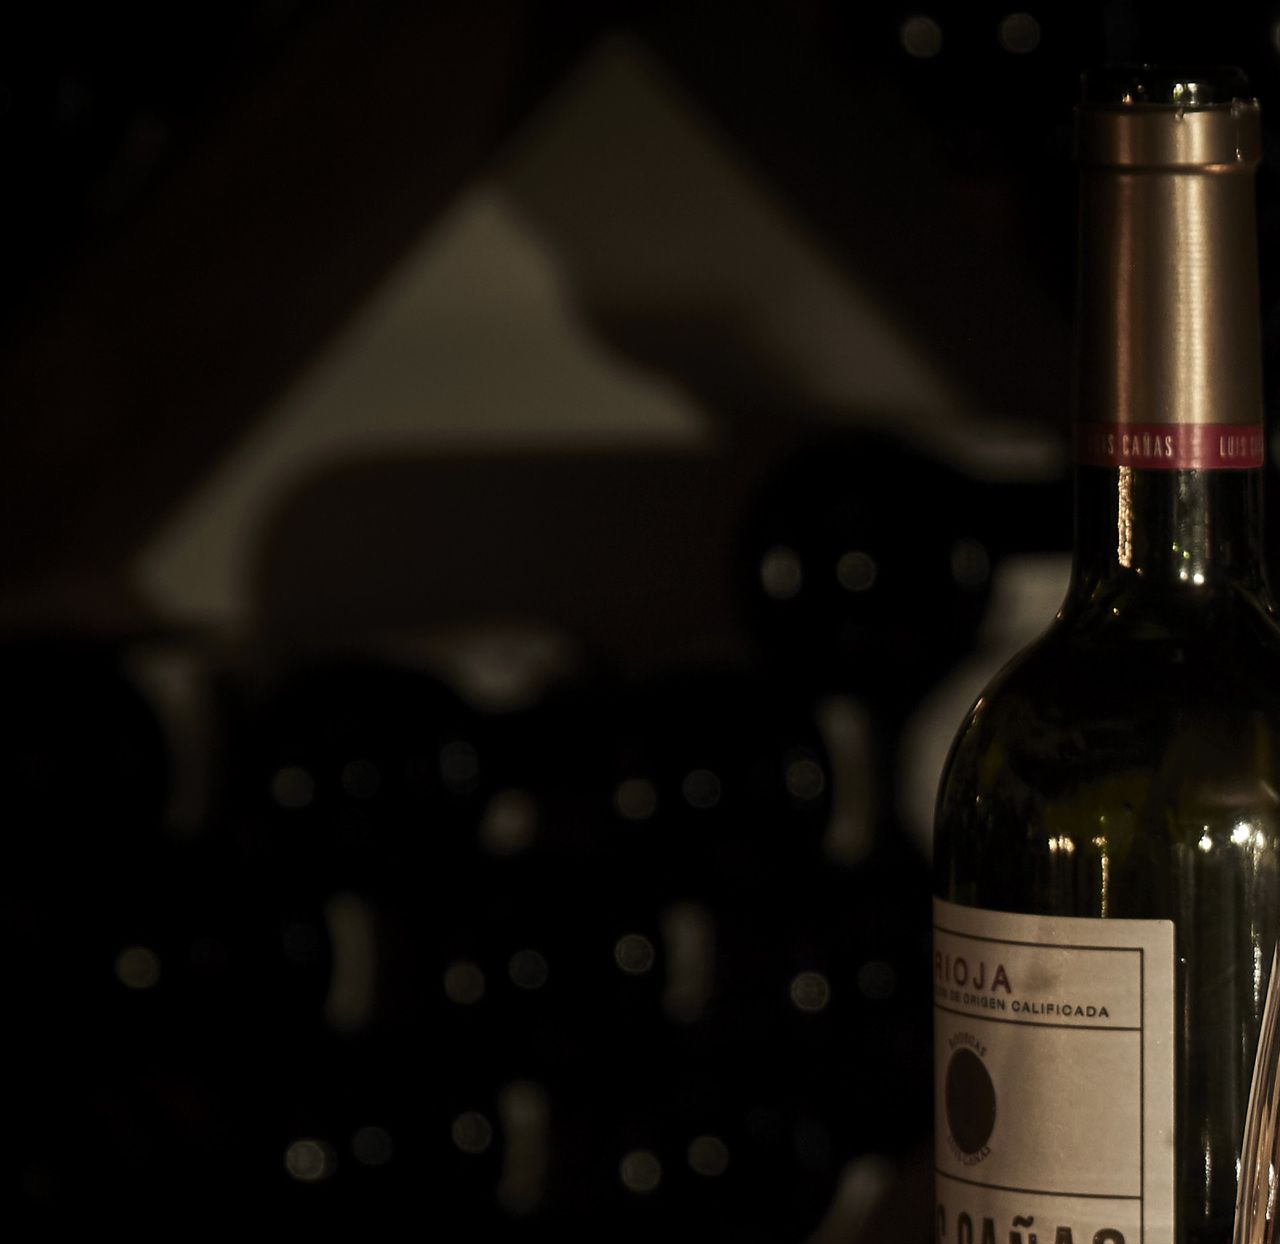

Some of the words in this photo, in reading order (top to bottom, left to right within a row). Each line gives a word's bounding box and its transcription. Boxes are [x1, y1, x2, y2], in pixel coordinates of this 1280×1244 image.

[935, 951, 1012, 994] RIOJA
[963, 992, 1006, 1011] ORIGEN
[1011, 1000, 1110, 1018] CALIFICADA
